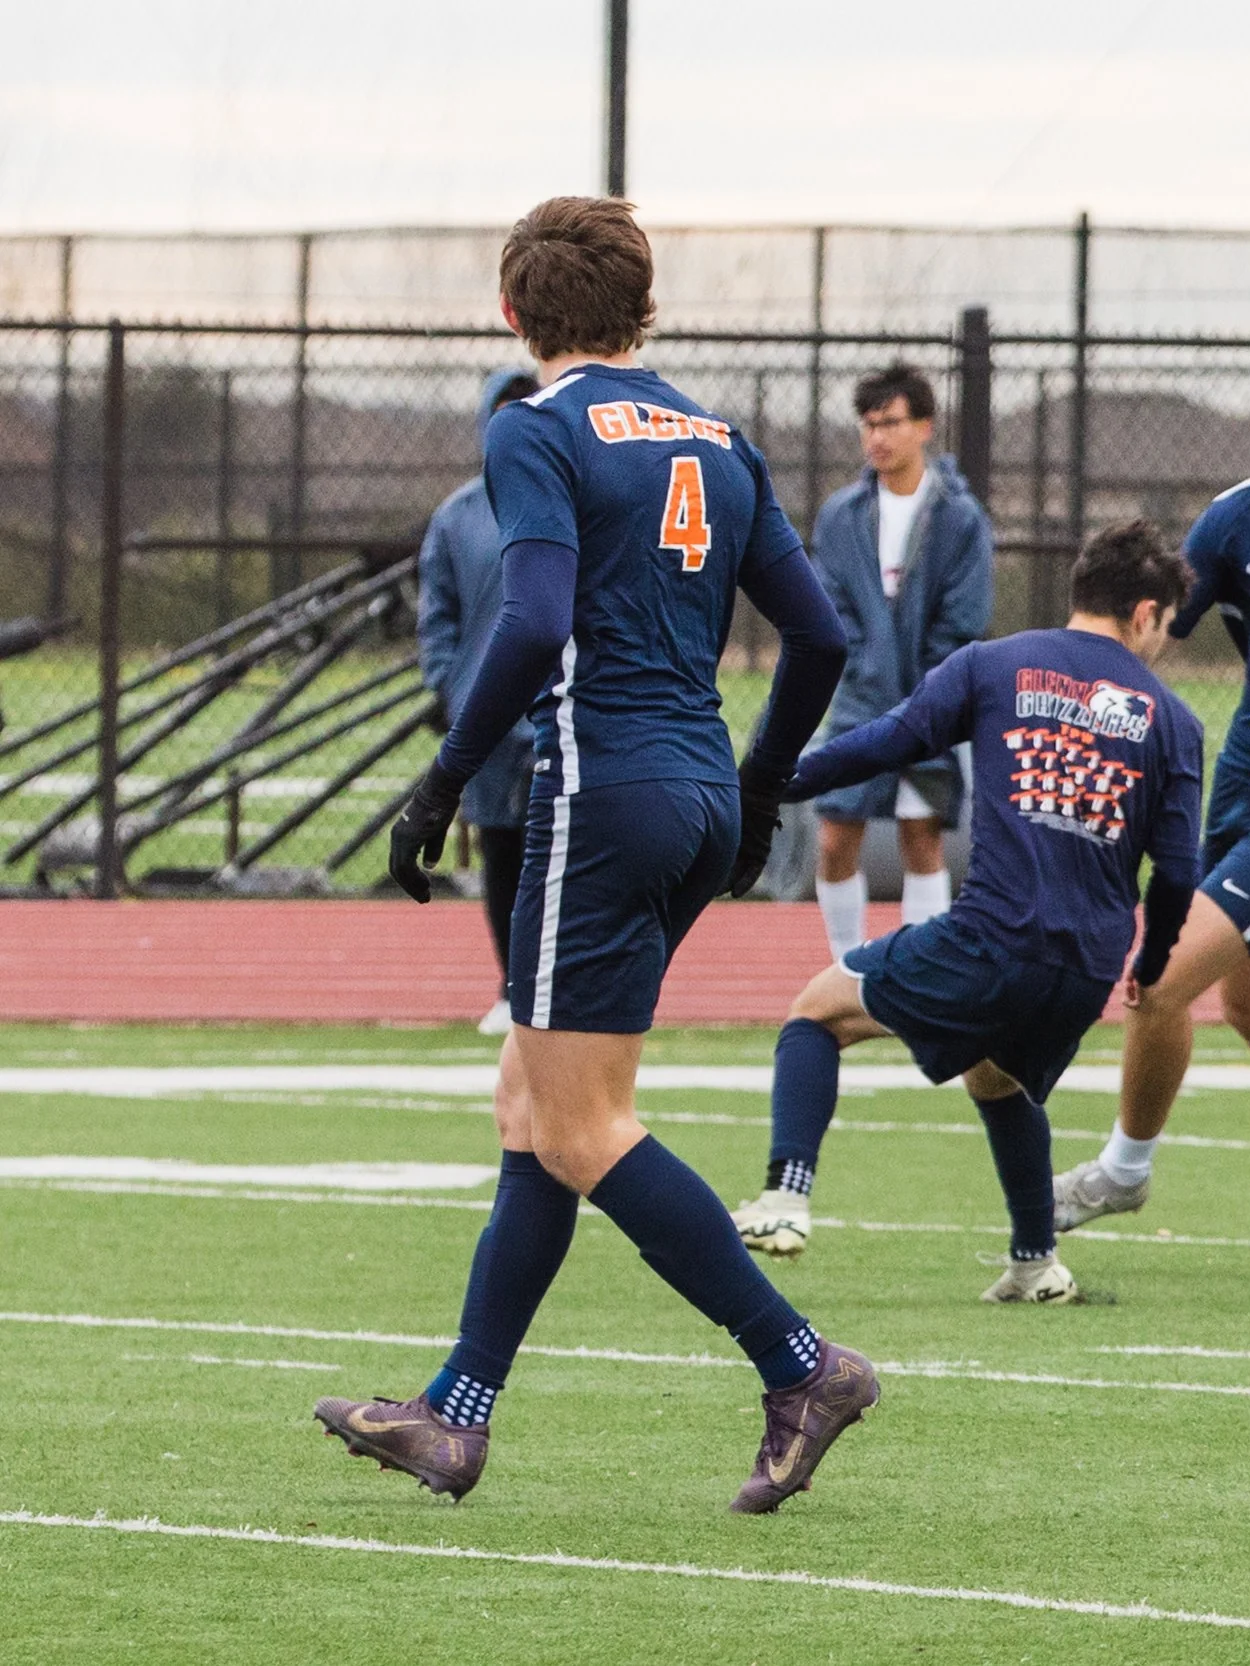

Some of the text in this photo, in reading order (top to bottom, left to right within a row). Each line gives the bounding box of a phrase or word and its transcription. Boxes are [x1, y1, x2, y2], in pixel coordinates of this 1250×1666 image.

[588, 401, 732, 449] GLENN
[658, 456, 712, 572] 4
[1016, 668, 1090, 702] GLENN
